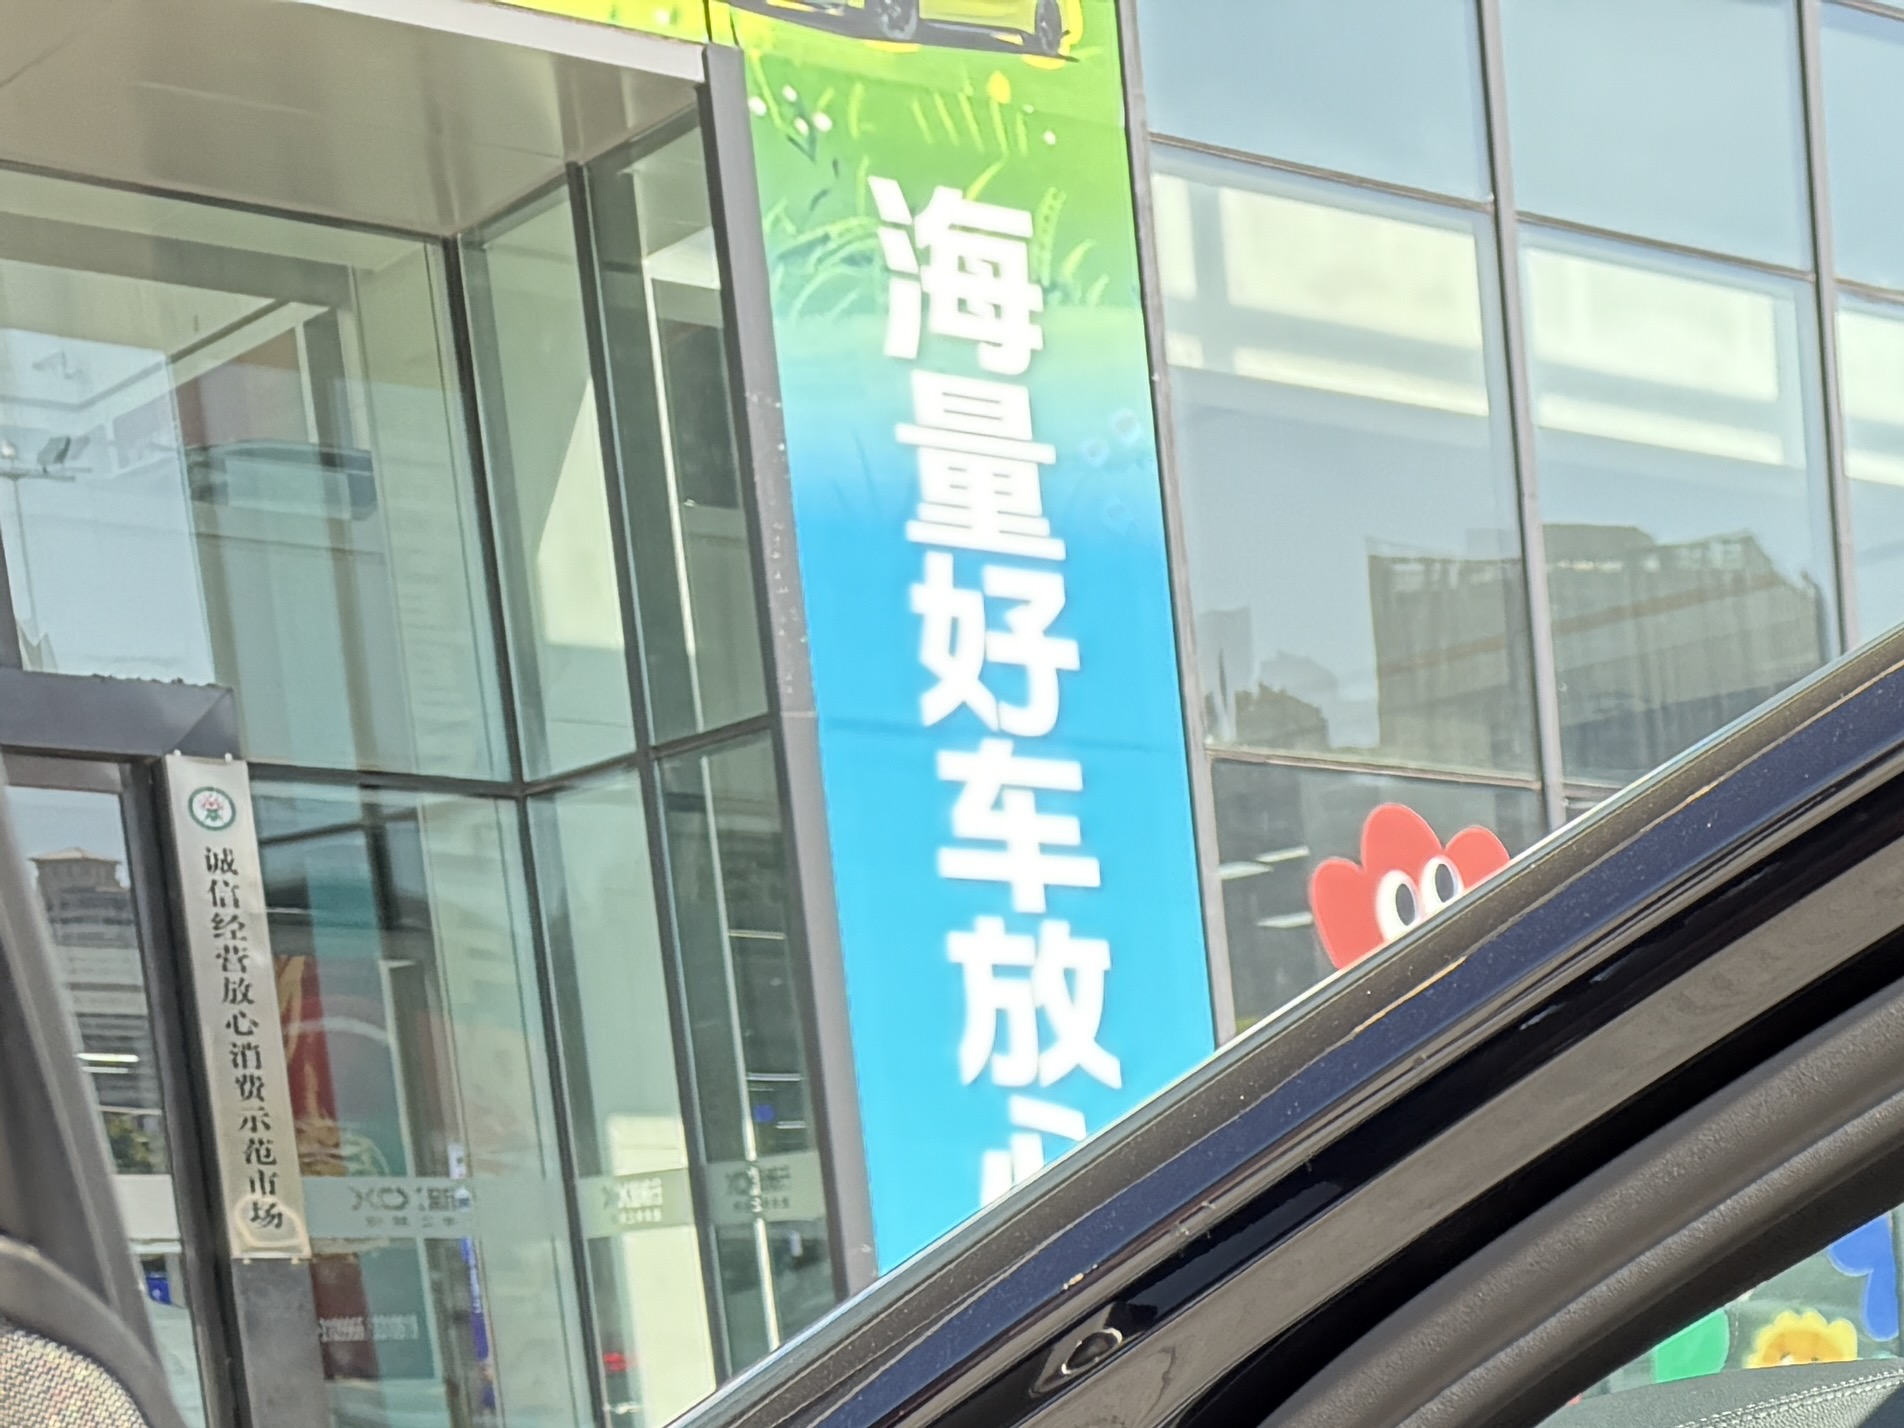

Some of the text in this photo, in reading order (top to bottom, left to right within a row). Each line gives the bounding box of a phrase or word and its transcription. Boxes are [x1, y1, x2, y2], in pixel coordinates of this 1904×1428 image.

[204, 846, 284, 1231] 诚信经营放心消费示范市场
